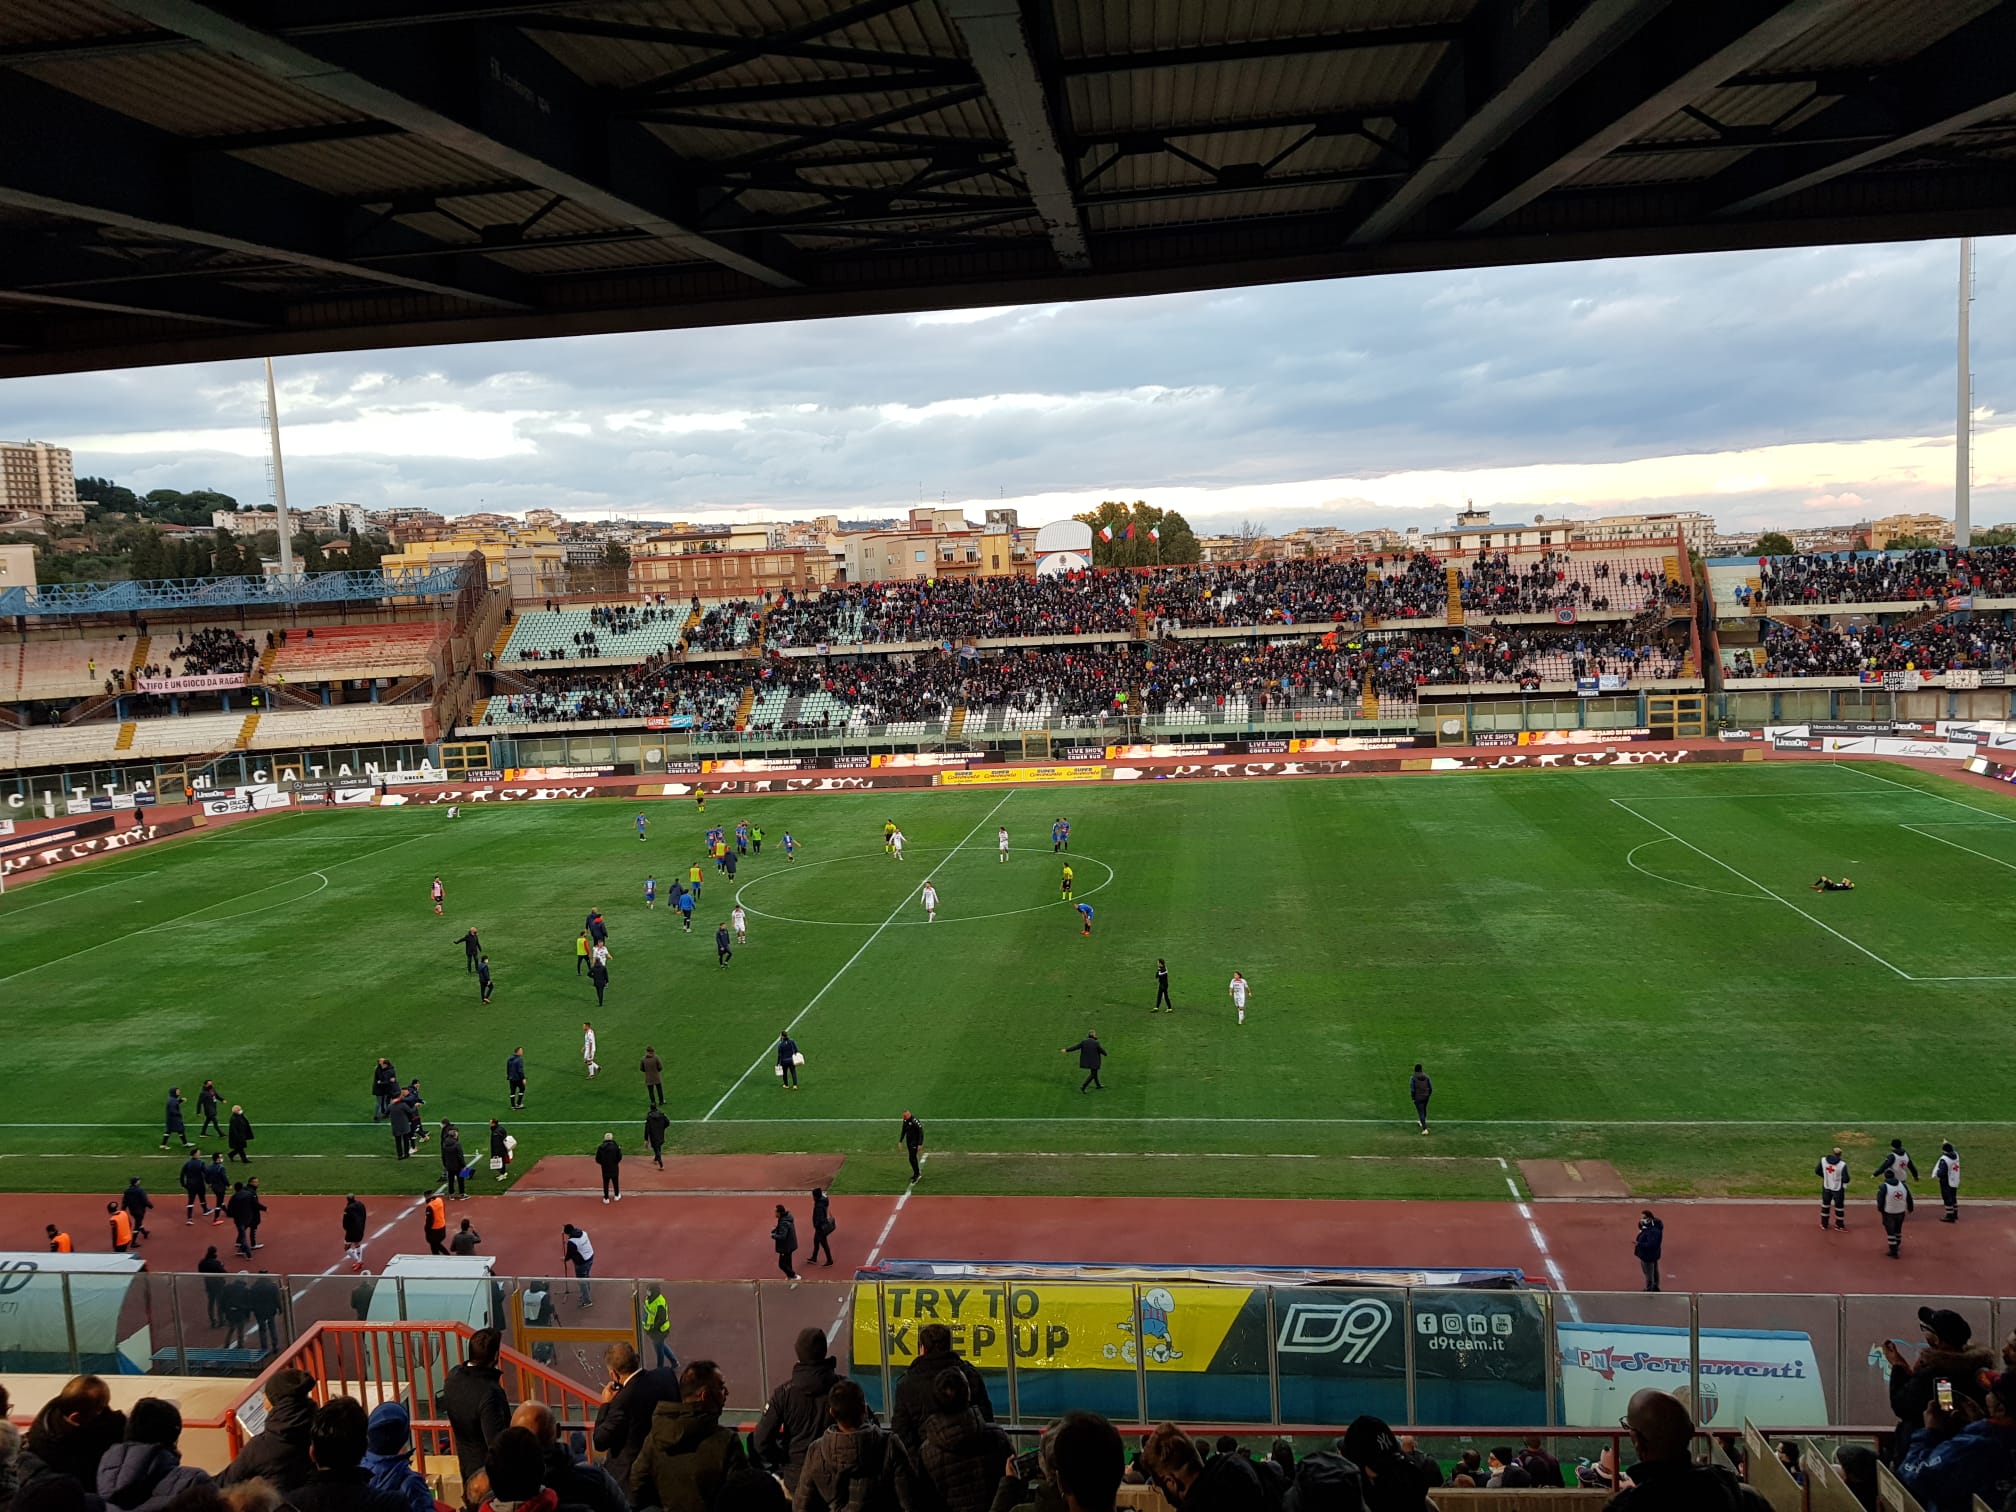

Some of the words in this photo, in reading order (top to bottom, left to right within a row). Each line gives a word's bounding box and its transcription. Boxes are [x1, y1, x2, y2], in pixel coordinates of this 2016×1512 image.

[146, 682, 163, 690] TIFO
[171, 680, 181, 688] UN
[183, 679, 205, 688] GIOCO
[207, 678, 217, 686] DA
[192, 774, 211, 789] di
[253, 758, 433, 784] CATANIA
[887, 1288, 970, 1318] TRY
[983, 1288, 1040, 1320] TO
[887, 1322, 996, 1357] KEP
[1014, 1324, 1070, 1358] UP
[1277, 1298, 1393, 1363] D9
[1429, 1336, 1505, 1351] d9team.it
[1579, 1349, 1608, 1371] PN
[1620, 1351, 1807, 1379] Serramenti
